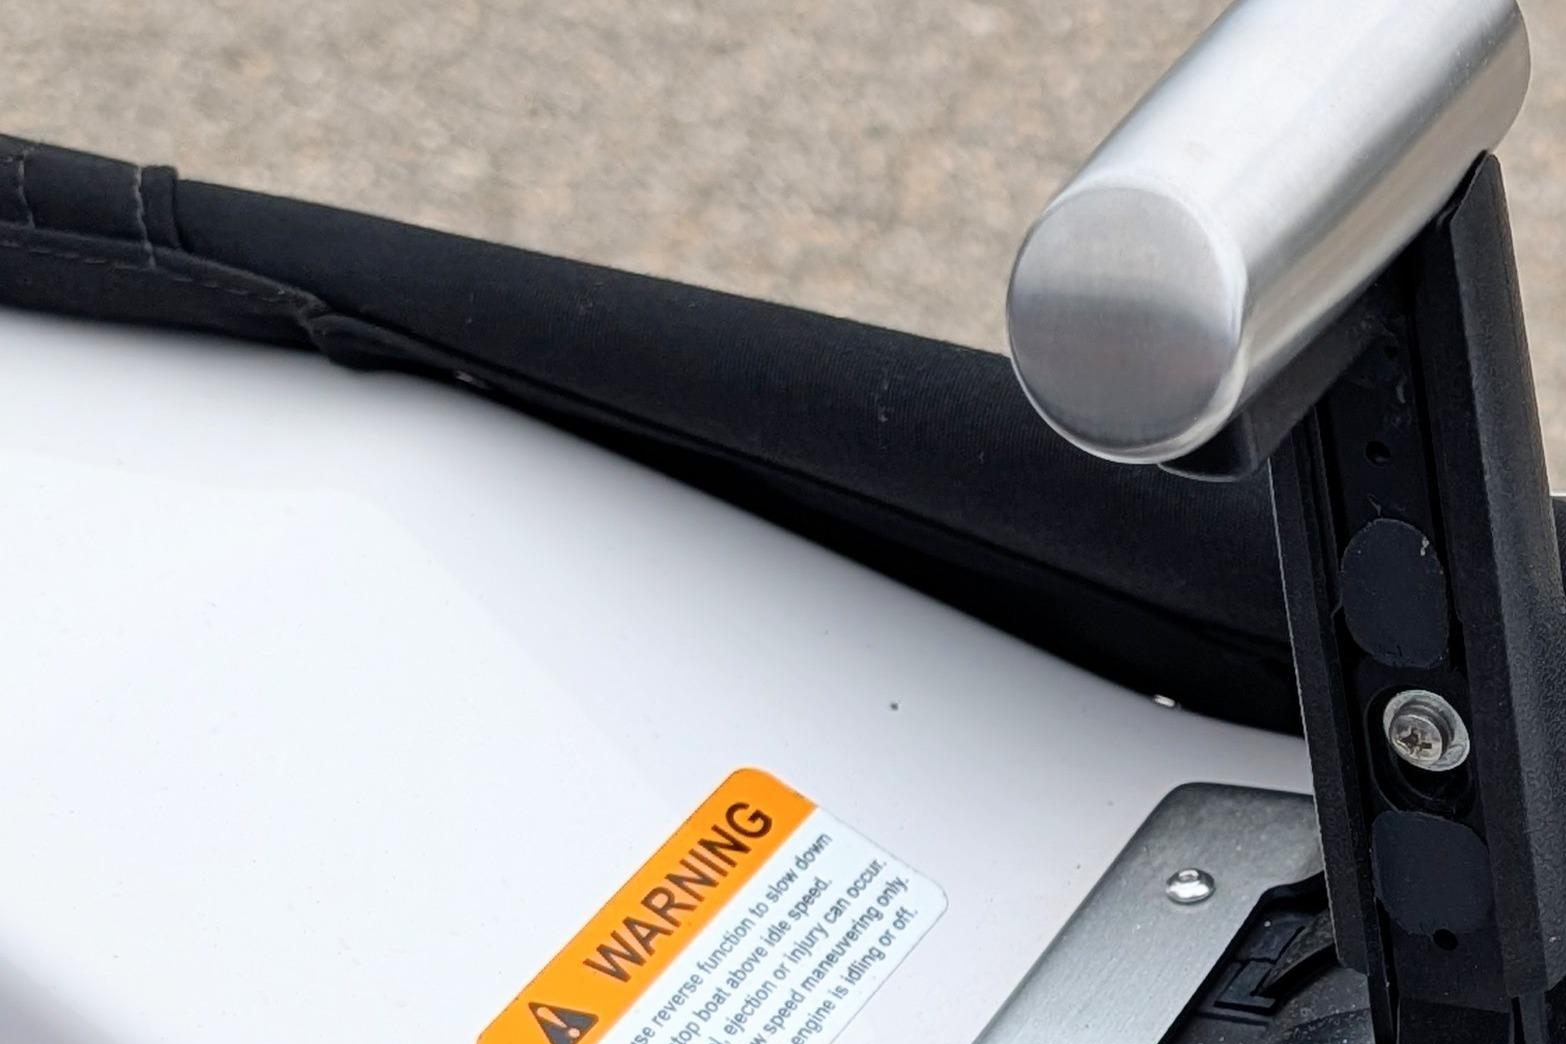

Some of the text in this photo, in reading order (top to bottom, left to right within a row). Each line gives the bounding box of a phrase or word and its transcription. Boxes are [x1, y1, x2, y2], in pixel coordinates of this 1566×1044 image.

[583, 802, 773, 983] WARNING
[651, 974, 704, 1027] reverse
[696, 918, 756, 974] function
[748, 902, 769, 919] to
[765, 868, 798, 903] slow
[794, 834, 832, 871] down
[692, 987, 731, 1022] boat
[726, 946, 768, 989] above
[760, 920, 792, 947] idle
[787, 876, 832, 921] speed.
[723, 980, 777, 1036] ejection
[773, 962, 791, 980] or
[783, 922, 829, 964] injury
[823, 897, 851, 924] can
[846, 859, 887, 899] occur.
[762, 988, 806, 1035] speed
[800, 906, 884, 992] maneuvering
[876, 876, 909, 907] only.
[827, 985, 849, 1000] is
[840, 946, 886, 985] idling
[878, 929, 896, 947] or
[892, 906, 918, 930] off.
